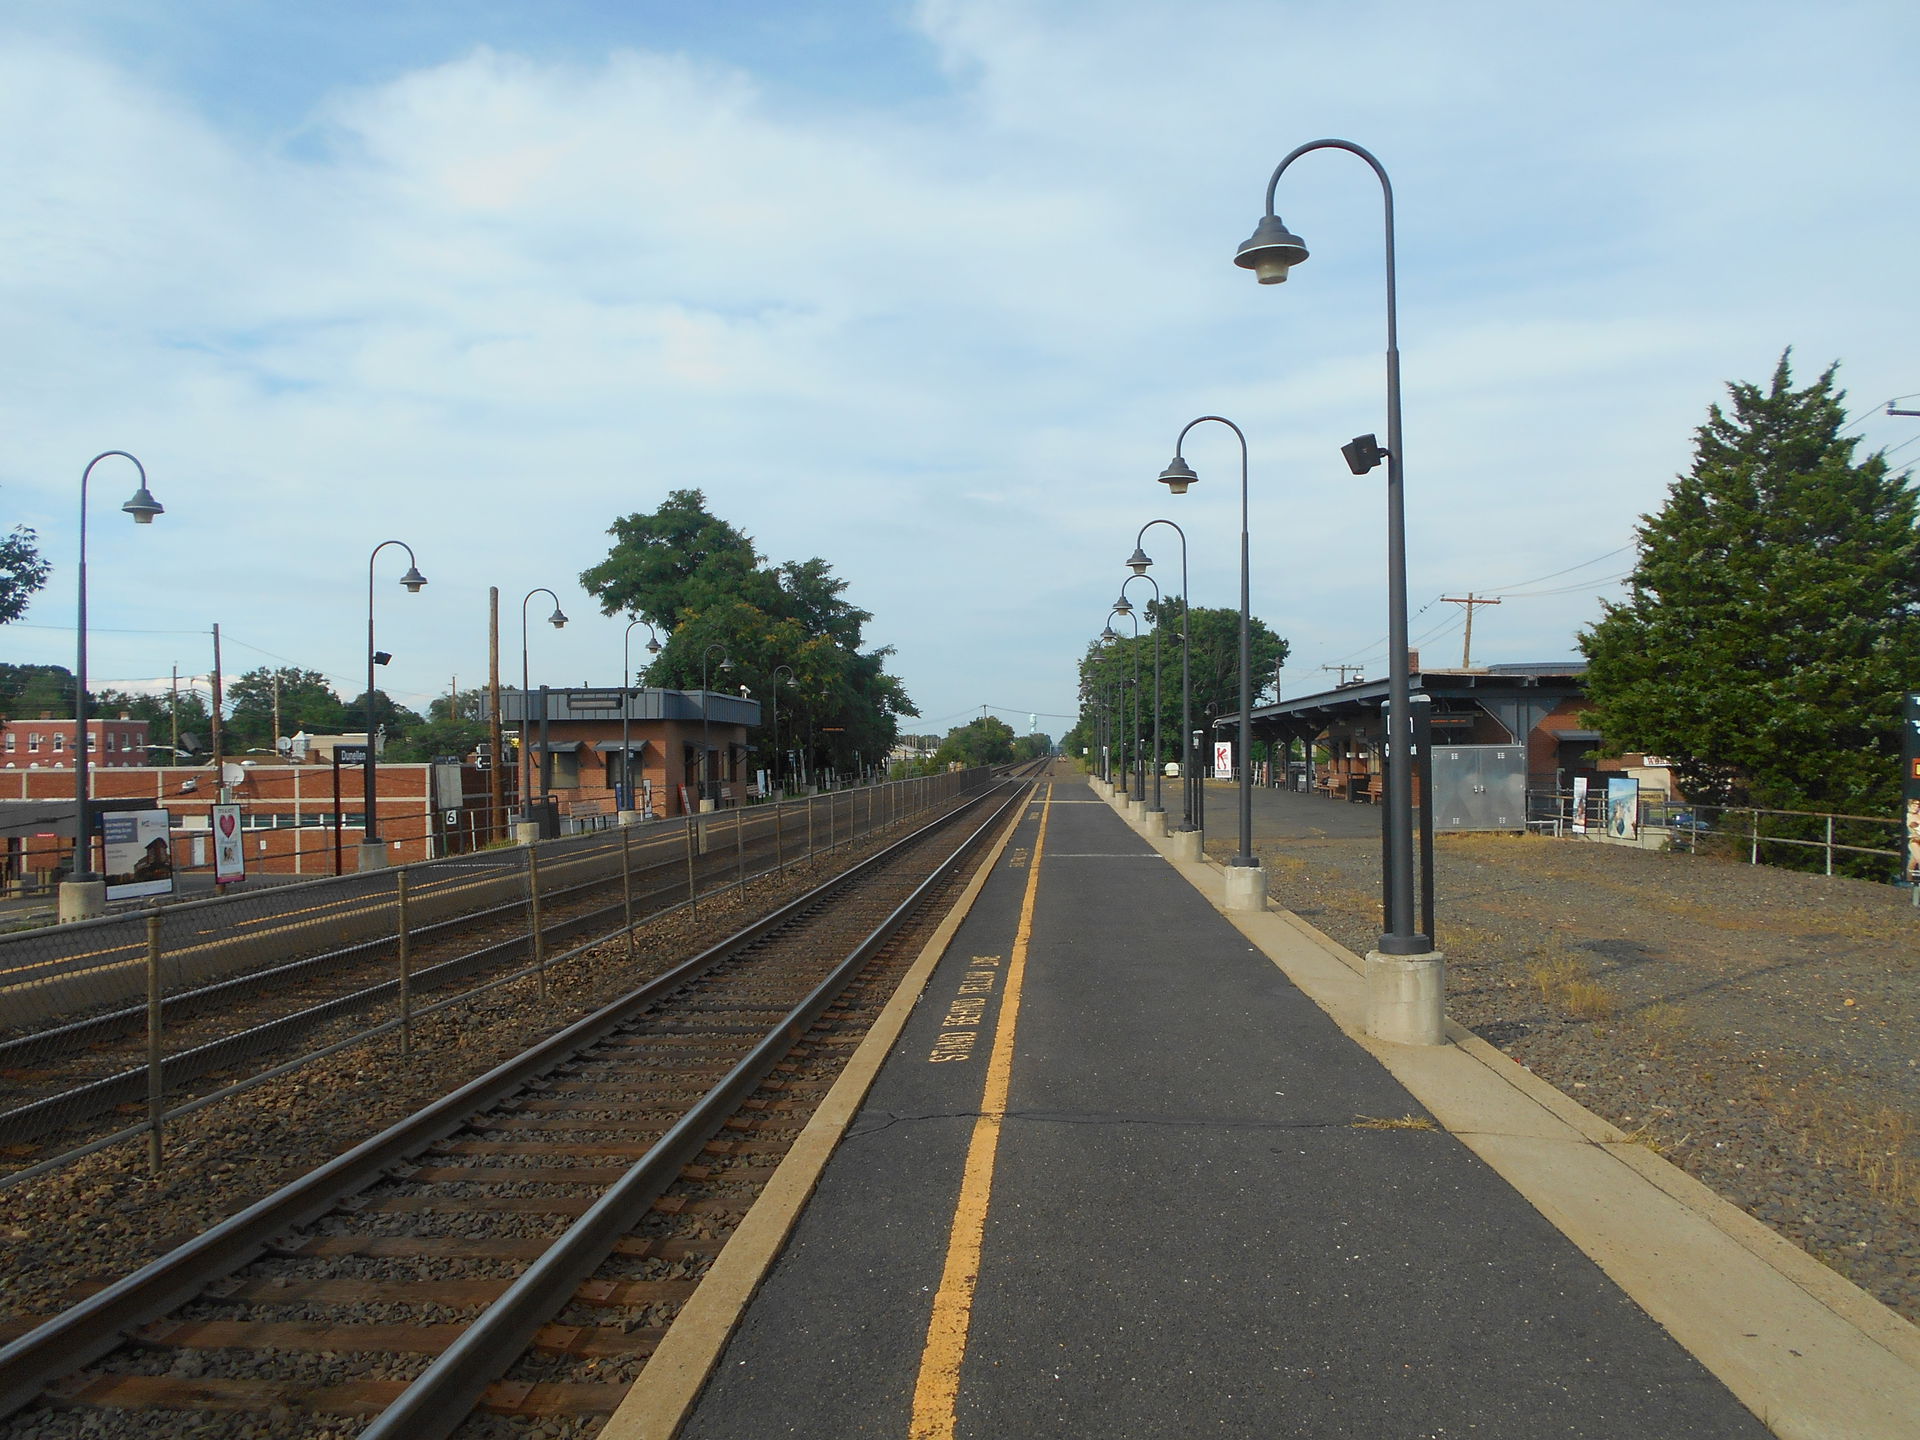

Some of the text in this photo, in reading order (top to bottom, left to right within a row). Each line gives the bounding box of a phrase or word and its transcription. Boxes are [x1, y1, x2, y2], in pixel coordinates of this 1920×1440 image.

[341, 750, 367, 761] Dunellen
[447, 811, 455, 823] 6
[941, 997, 986, 1027] BEHIND
[928, 1031, 977, 1063] STAND
